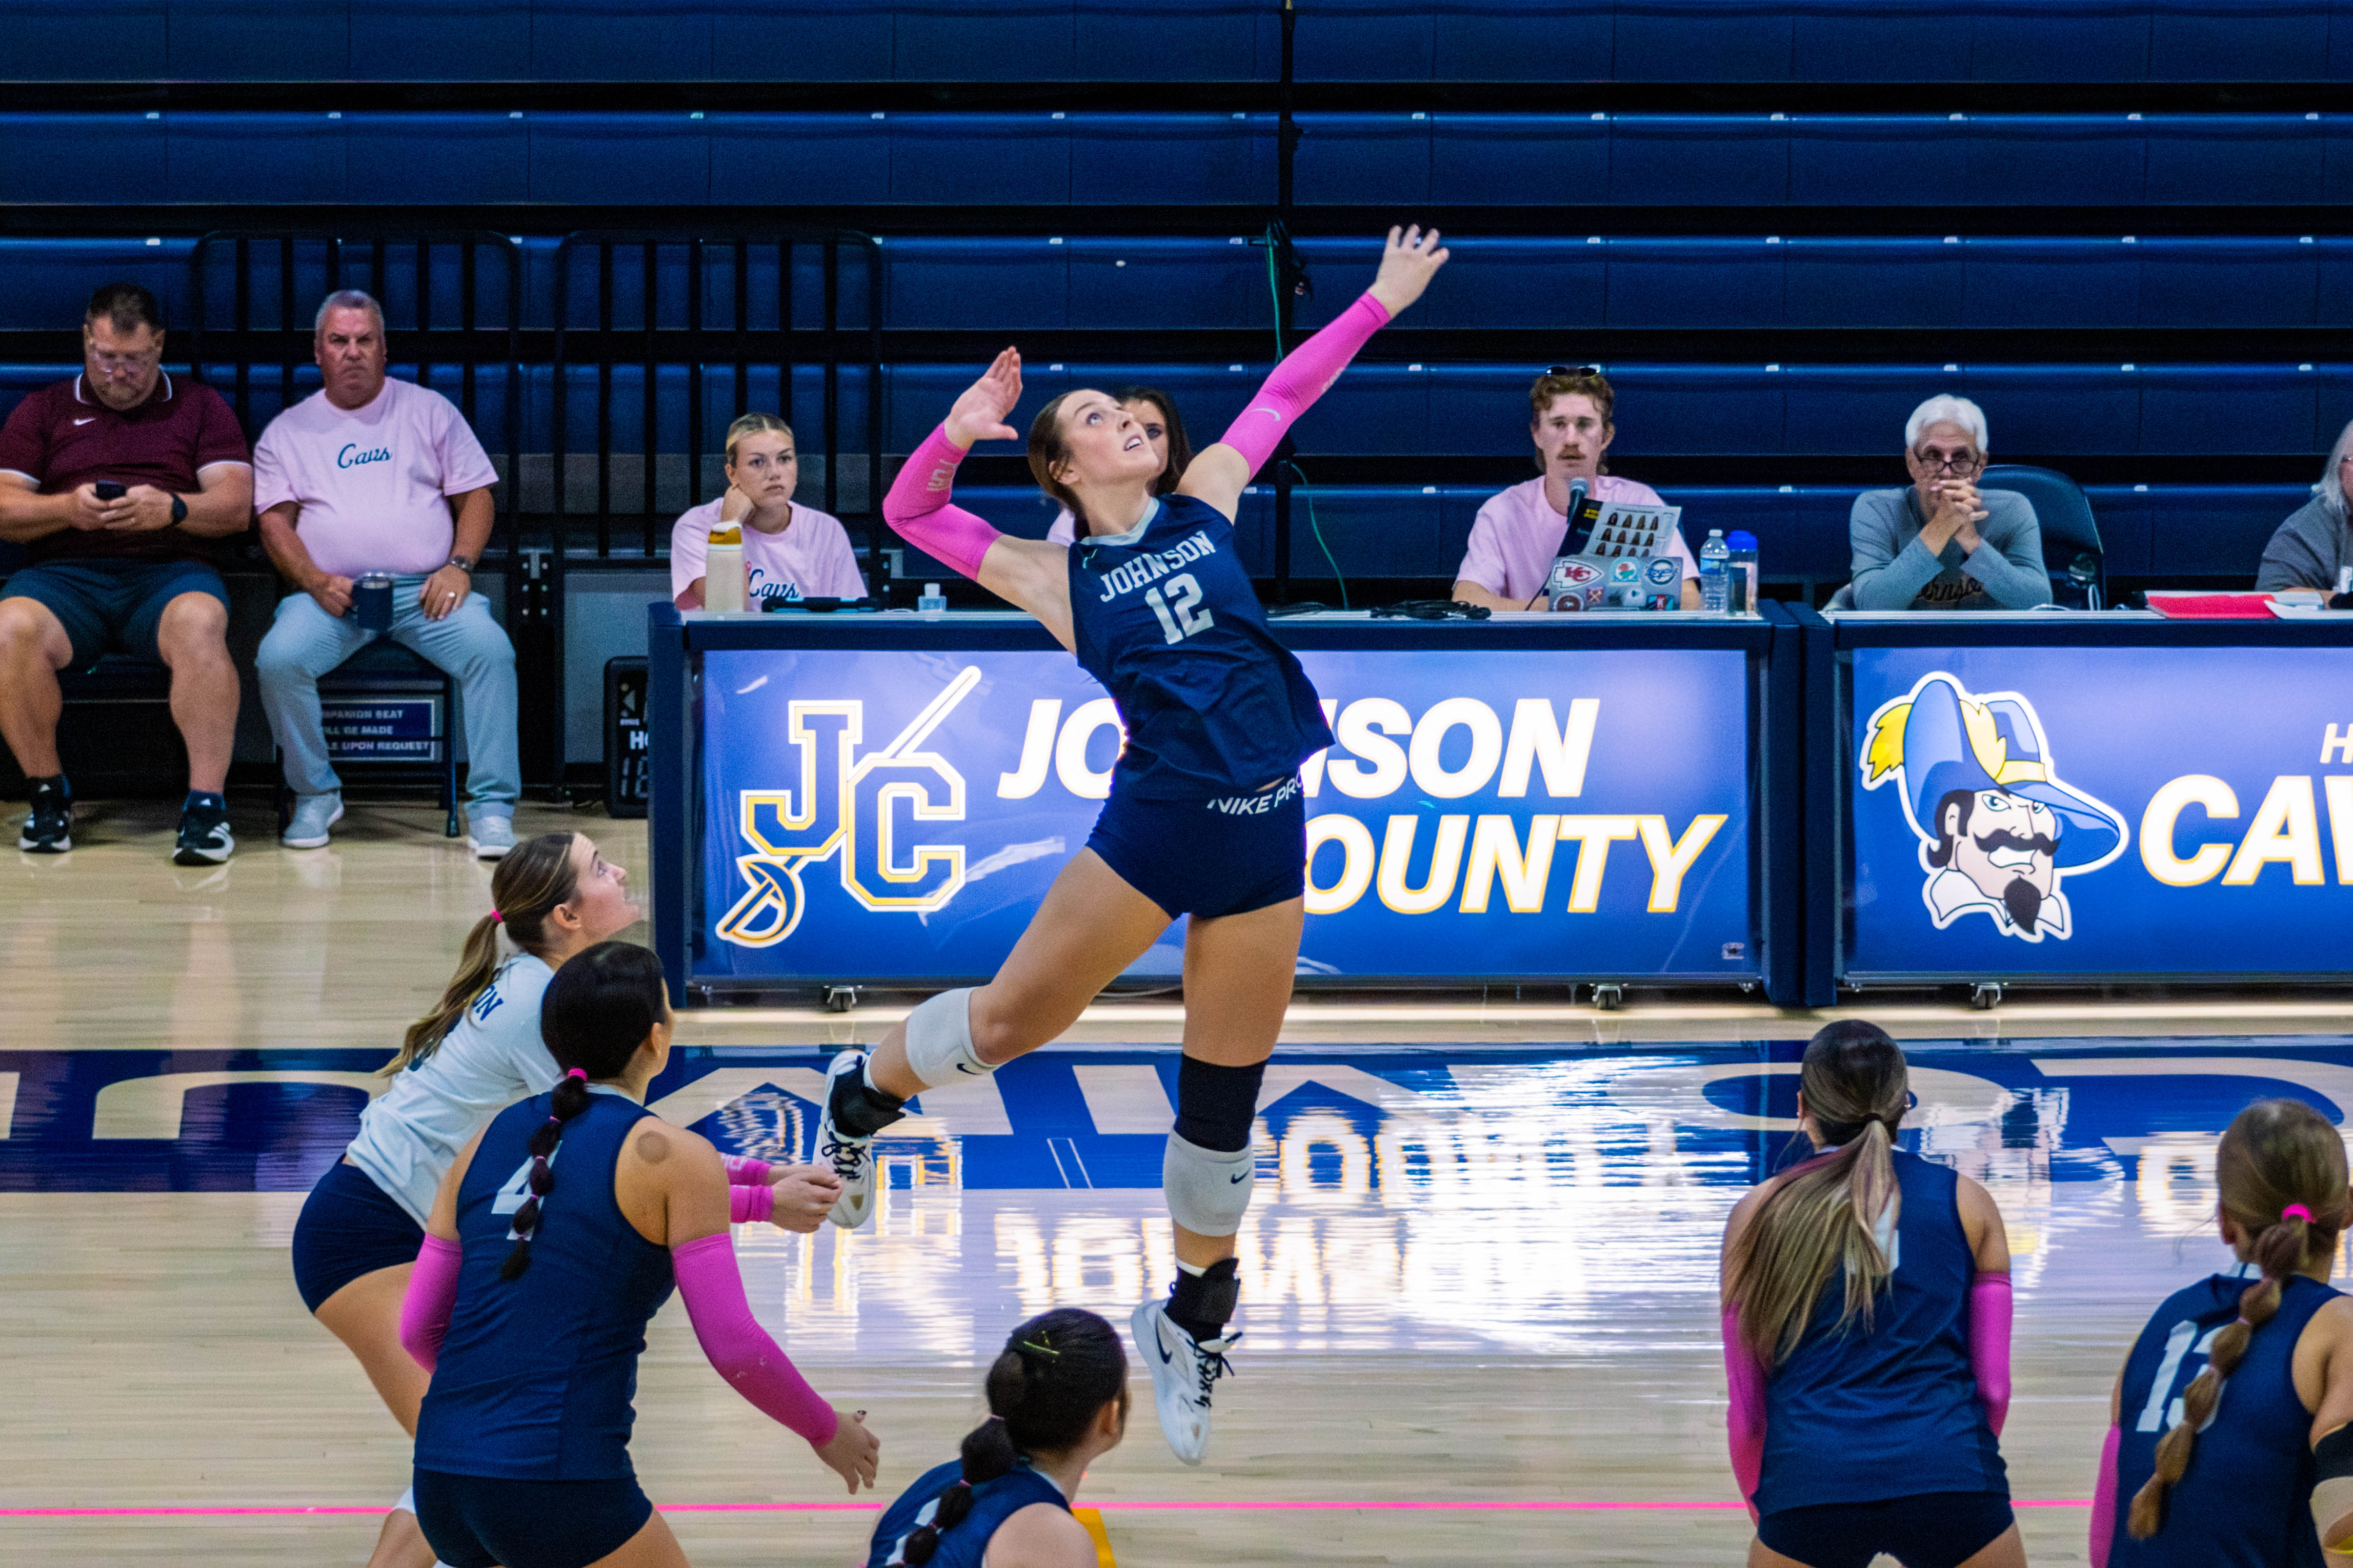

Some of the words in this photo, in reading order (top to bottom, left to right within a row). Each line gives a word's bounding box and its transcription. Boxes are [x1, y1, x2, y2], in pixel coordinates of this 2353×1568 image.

[337, 443, 393, 469] Cavs
[749, 568, 799, 599] Cavs
[1100, 530, 1216, 603] JOHNSON
[1144, 573, 1215, 645] 12
[340, 741, 375, 750] UPON
[376, 741, 429, 751] REQUEST
[360, 725, 394, 736] MADE
[375, 709, 403, 719] SEAT
[997, 698, 1600, 799] JOSON
[740, 699, 967, 912] JC
[1206, 794, 1273, 816] NIKE
[2139, 775, 2353, 887] CA
[1304, 813, 1728, 914] OUNTY
[491, 1139, 563, 1241] 4
